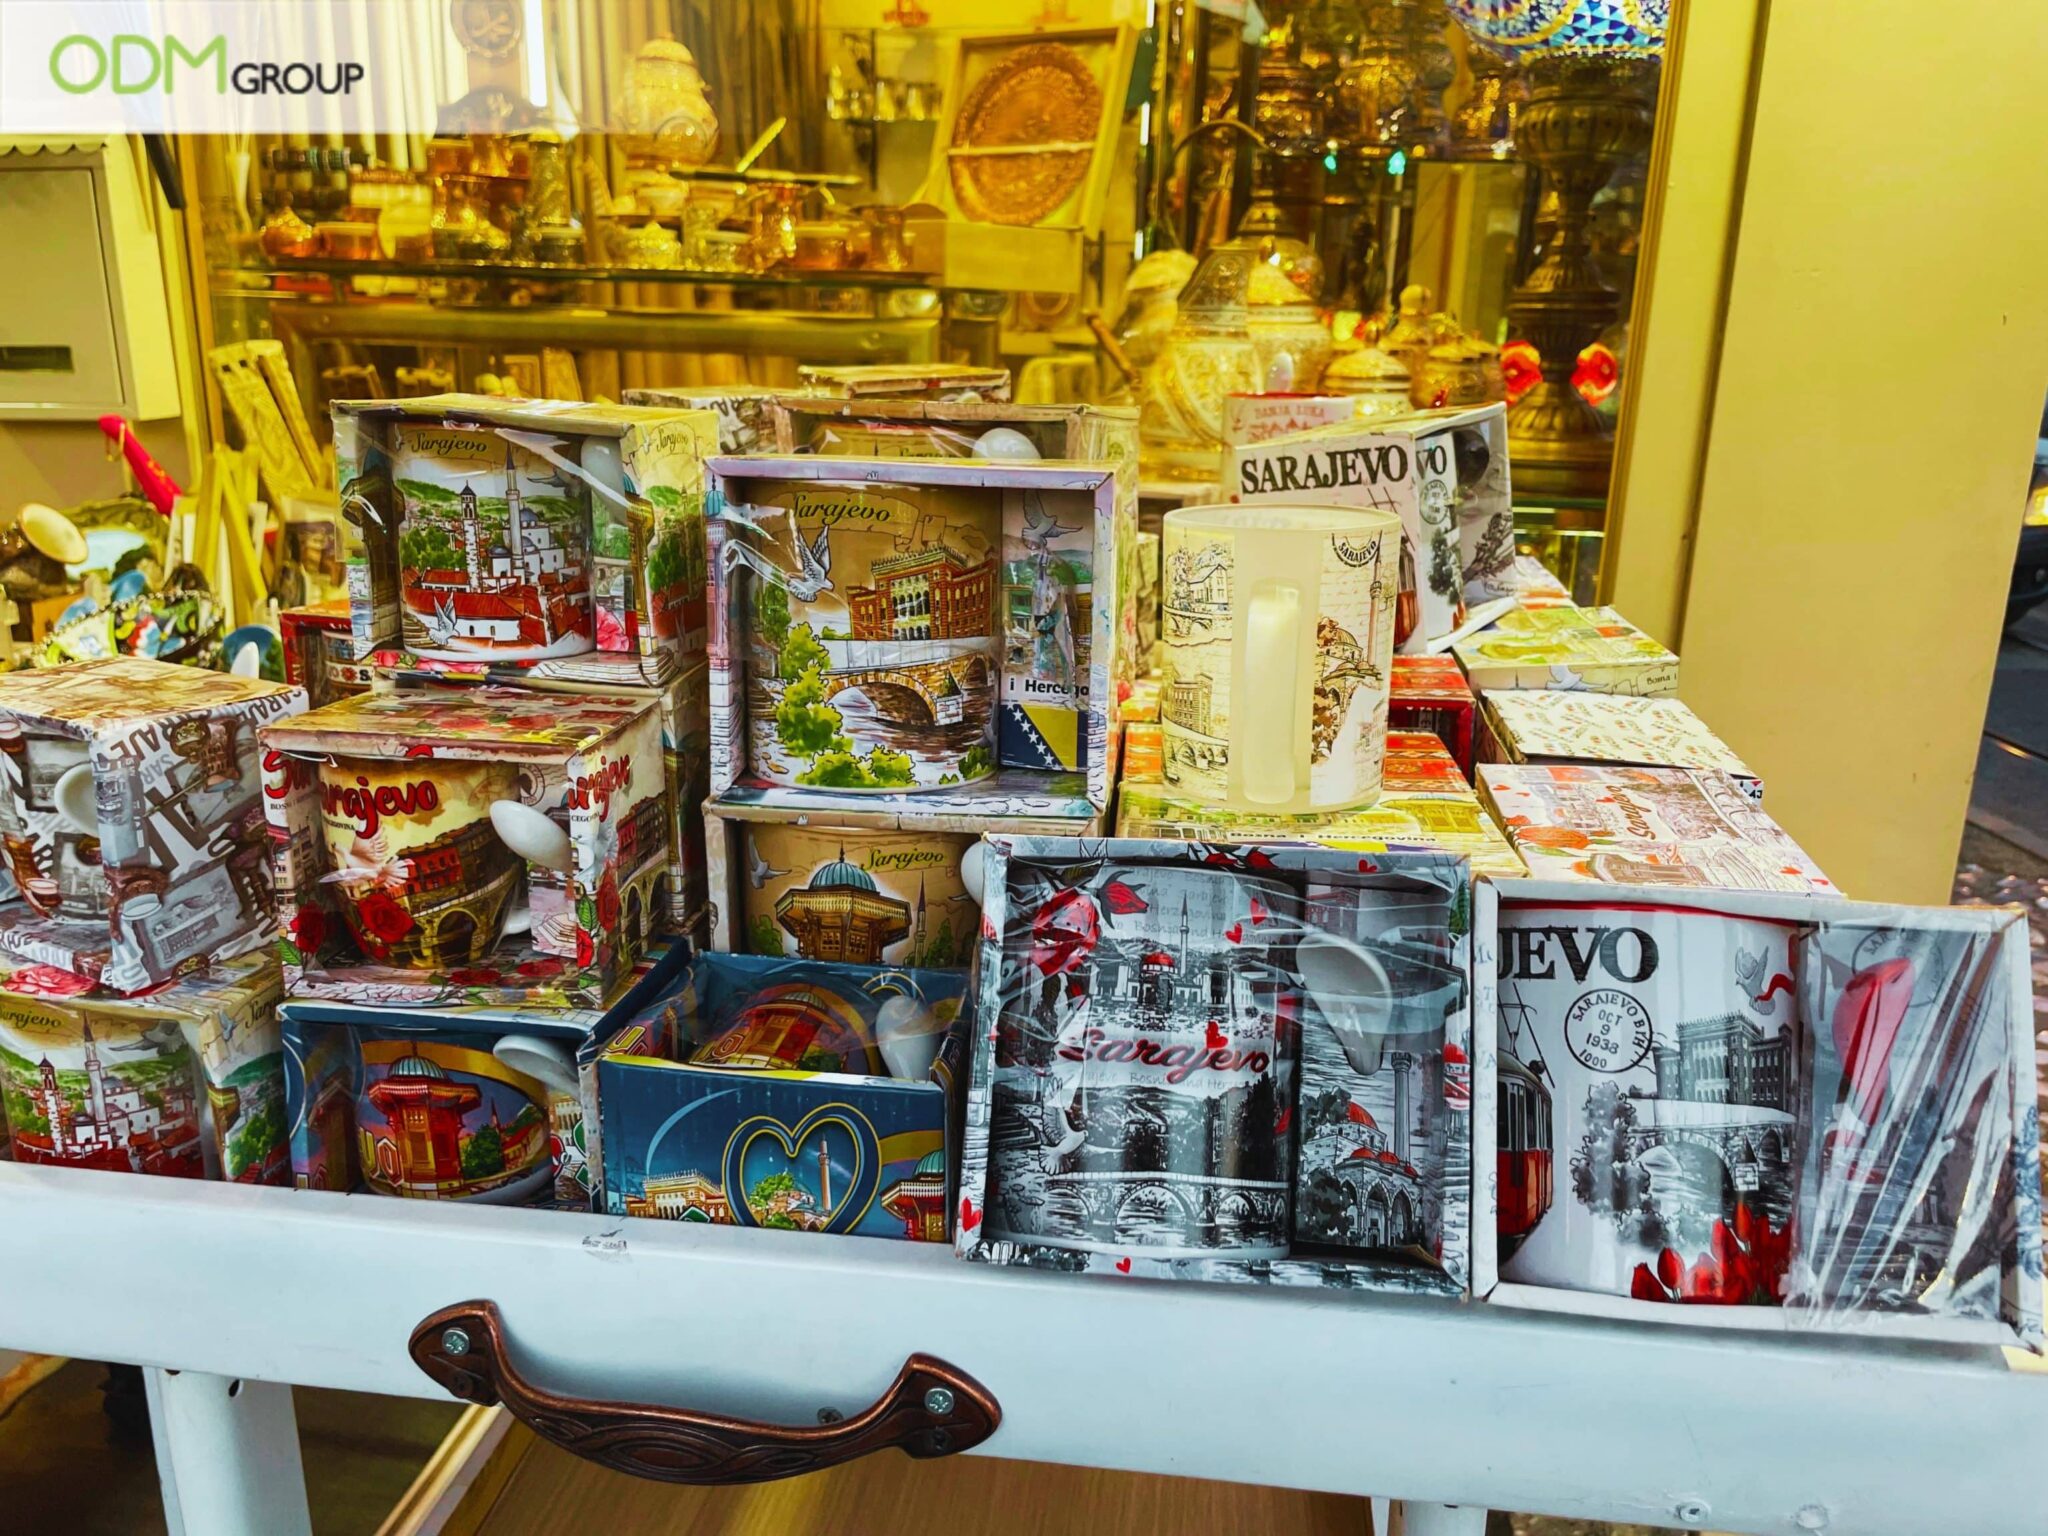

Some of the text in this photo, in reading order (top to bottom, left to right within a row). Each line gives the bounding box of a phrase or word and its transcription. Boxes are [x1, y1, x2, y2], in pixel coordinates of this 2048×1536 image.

[410, 433, 488, 454] Sarajevo
[1241, 444, 1408, 495] SARAJEVO
[786, 494, 891, 526] Sarajevo
[1338, 541, 1377, 562] SARAJEVO
[861, 847, 944, 869] Sarajevo
[1572, 992, 1638, 1022] SARAJEVO
[1598, 1009, 1623, 1026] OCT
[1601, 1023, 1611, 1036] 9
[1585, 1033, 1620, 1055] 1938
[1058, 1028, 1270, 1084] Sarajevo
[1579, 1048, 1608, 1069] 1000
